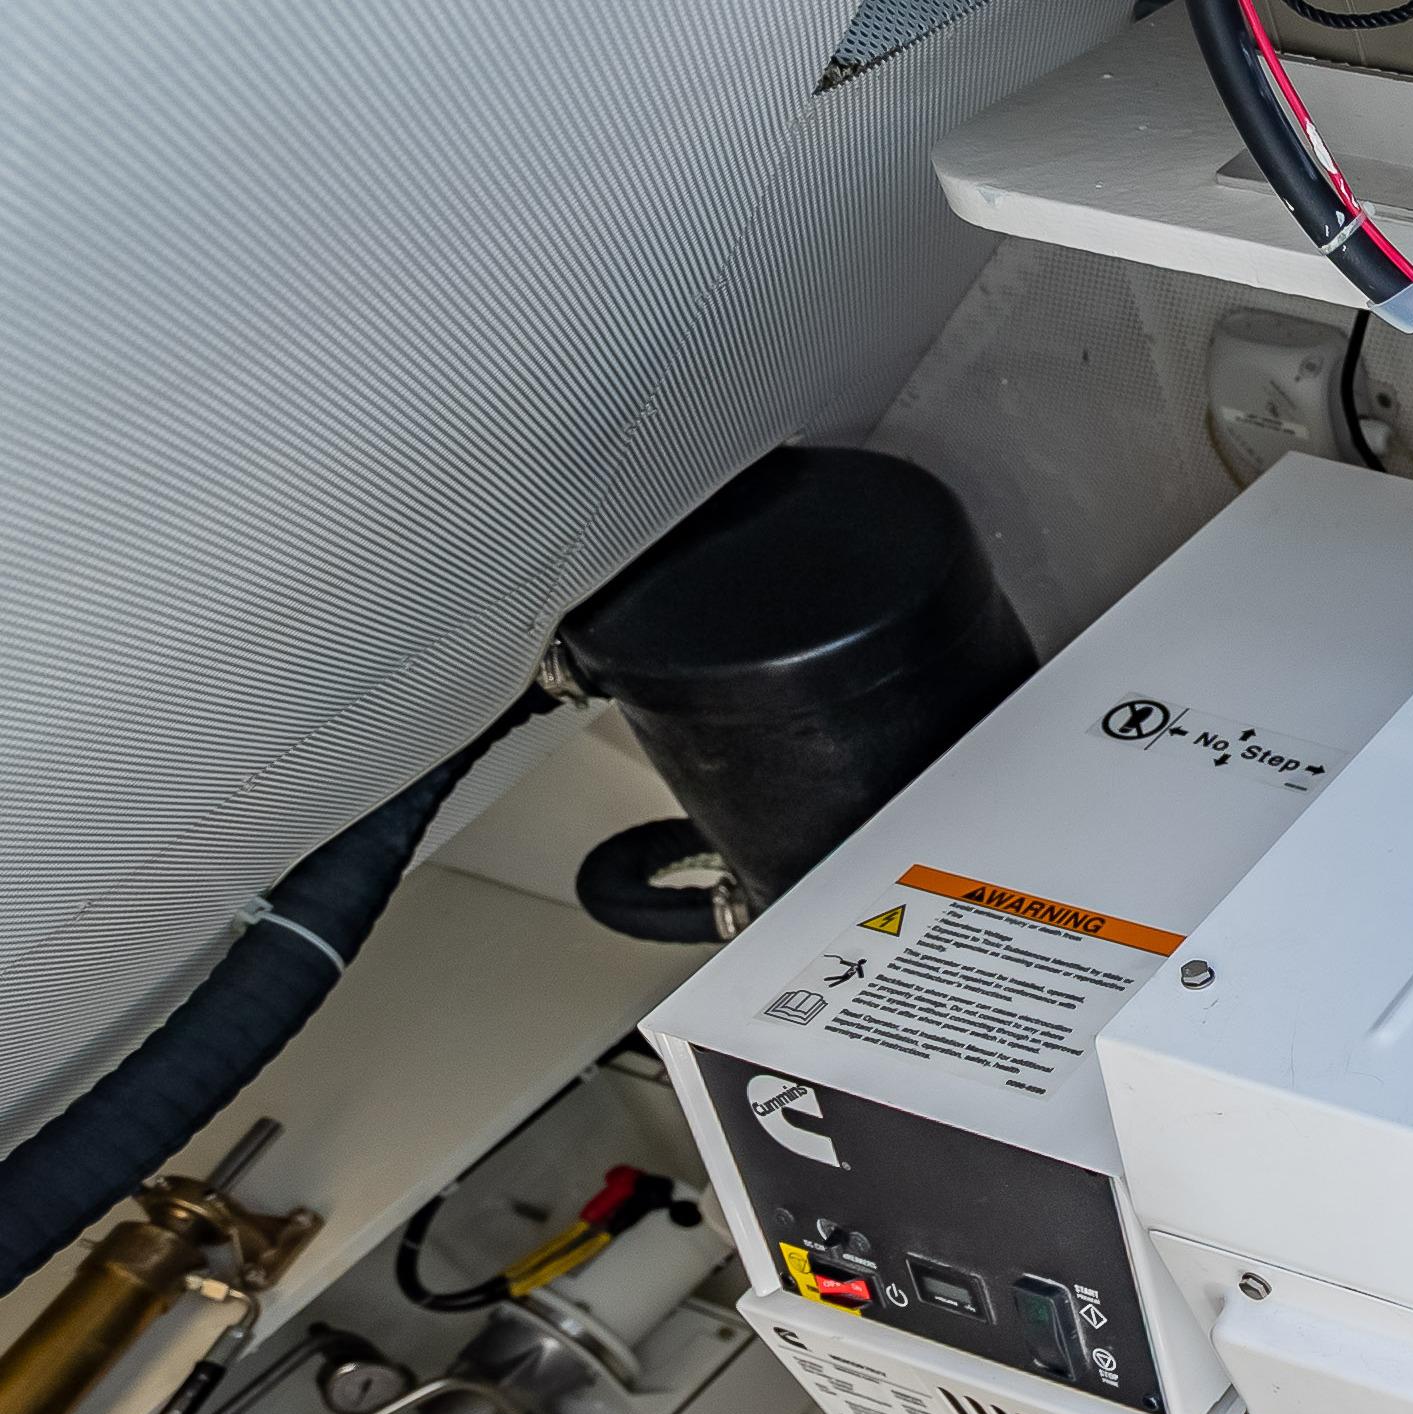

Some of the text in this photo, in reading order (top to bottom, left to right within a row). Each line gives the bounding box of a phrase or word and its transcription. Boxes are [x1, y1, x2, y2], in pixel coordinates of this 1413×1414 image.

[1193, 732, 1300, 773] No Step
[985, 891, 1106, 934] WARNING
[752, 1085, 808, 1116] Cummins
[1074, 1284, 1099, 1299] START
